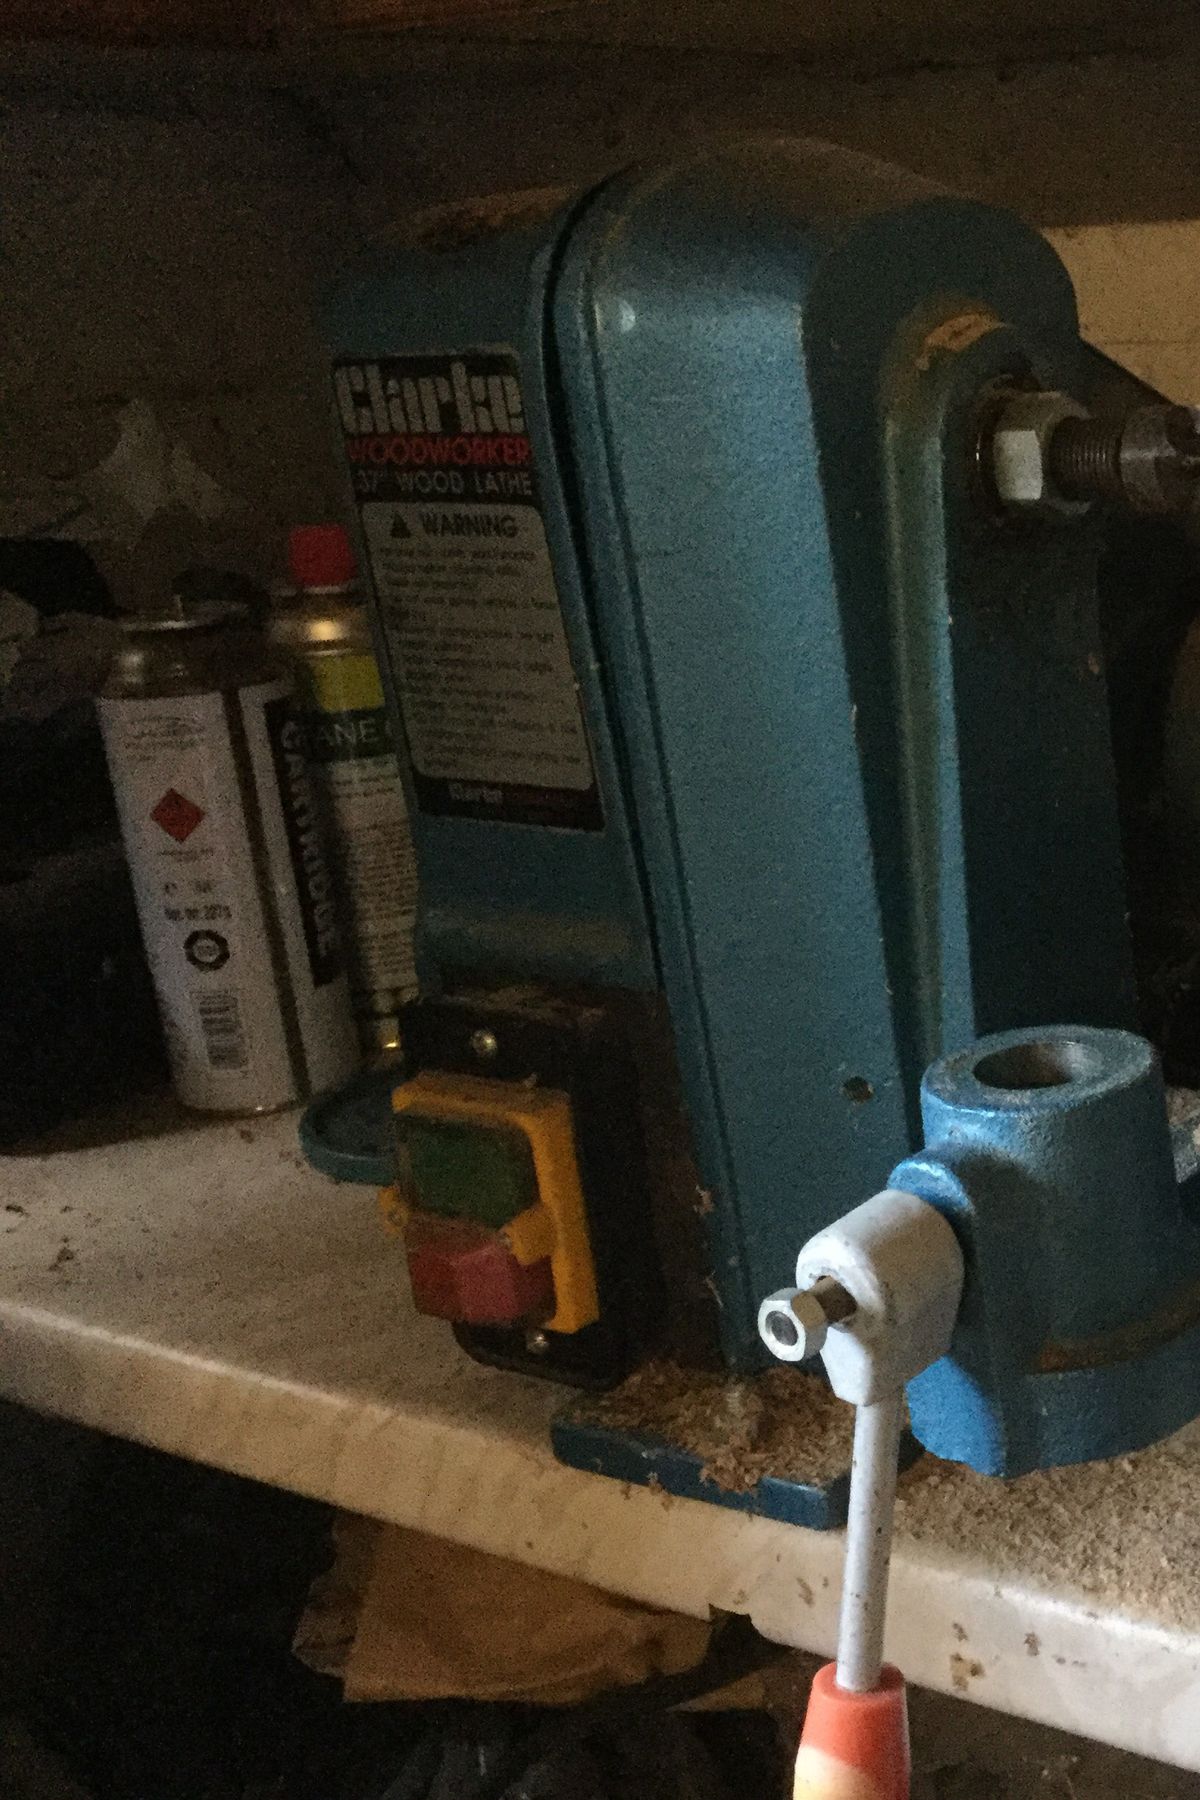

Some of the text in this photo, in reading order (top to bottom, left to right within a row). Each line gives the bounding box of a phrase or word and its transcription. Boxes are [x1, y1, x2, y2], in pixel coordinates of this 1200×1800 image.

[334, 361, 525, 434] Clarke
[348, 435, 532, 466] WOODWORKER
[396, 469, 465, 494] WOOD
[474, 471, 533, 497] LATHE
[419, 513, 519, 538] WARNING
